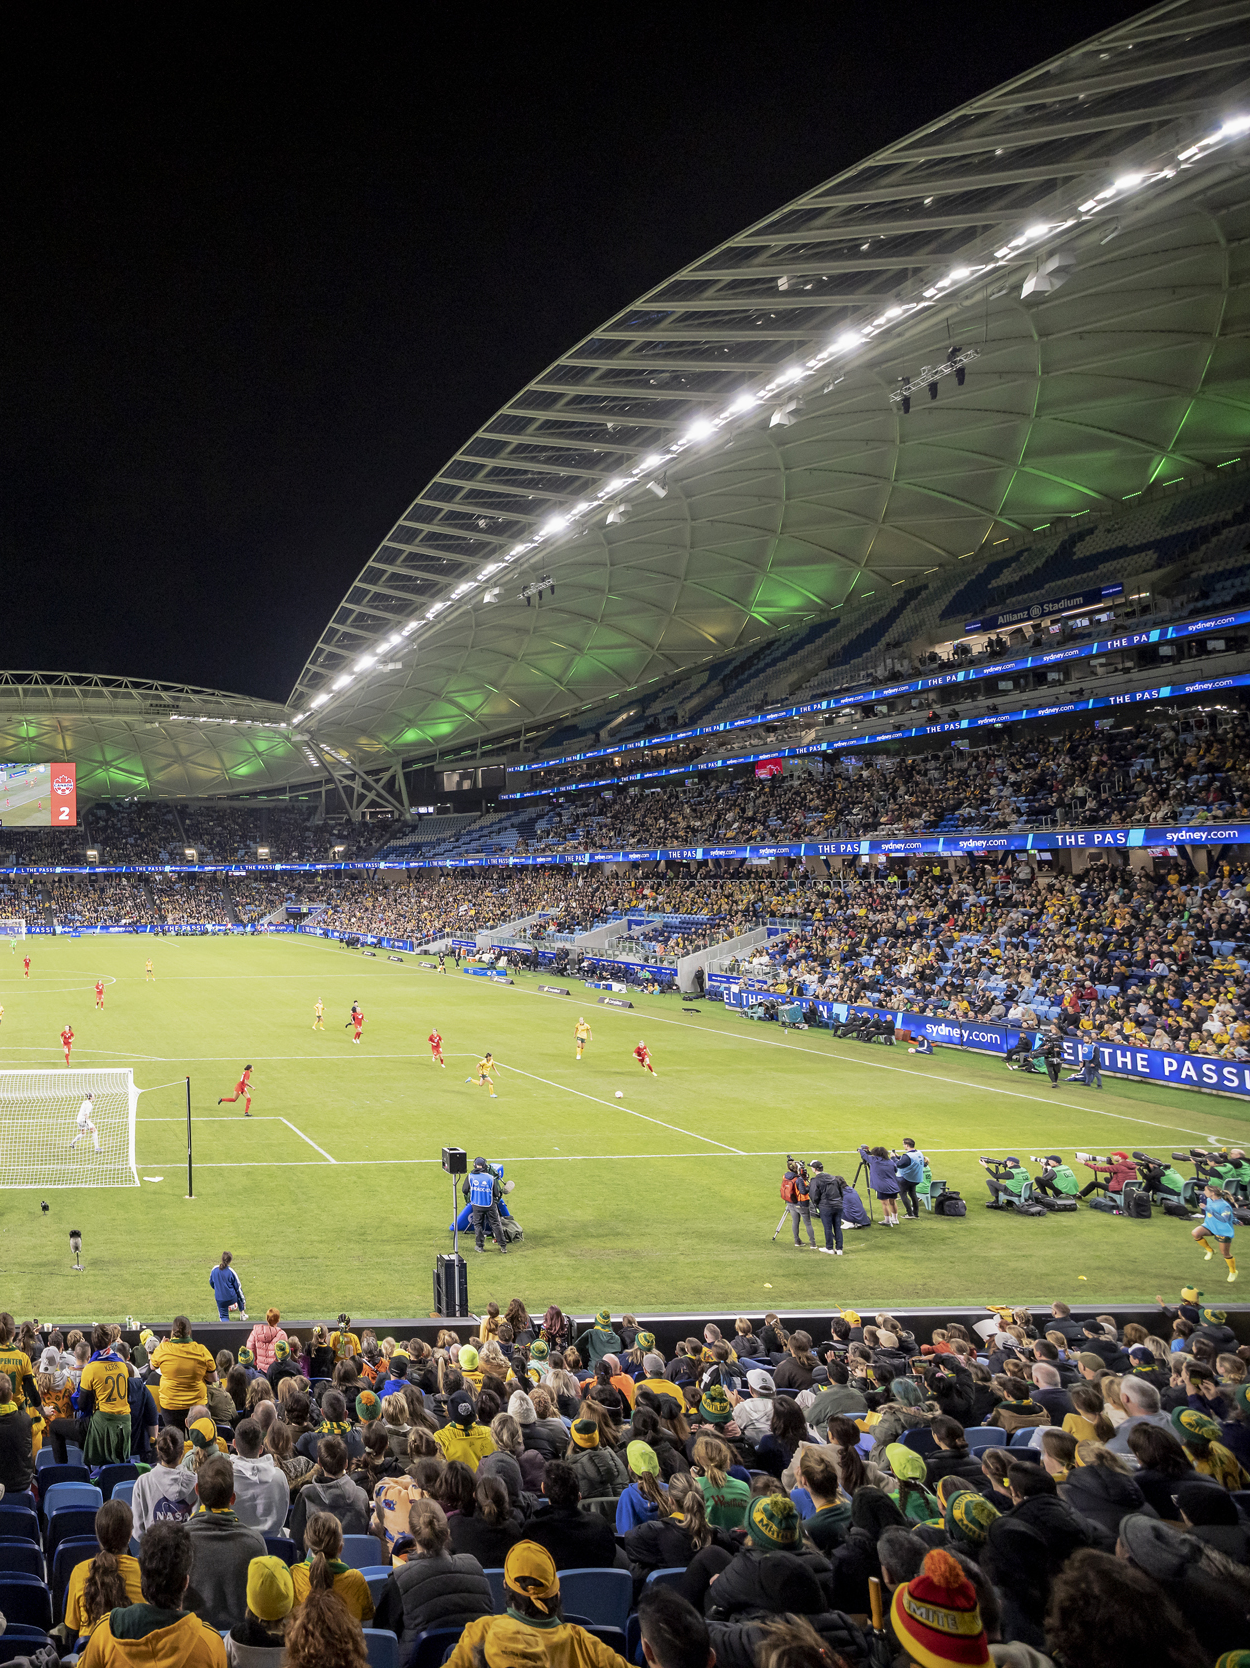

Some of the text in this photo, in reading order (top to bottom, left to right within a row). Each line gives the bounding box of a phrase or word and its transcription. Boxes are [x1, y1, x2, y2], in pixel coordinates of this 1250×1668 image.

[998, 597, 1083, 625] Allianz Stadium
[1188, 617, 1234, 631] sydney.com
[1108, 638, 1127, 648] THE
[1043, 650, 1079, 661] sydney.com
[984, 663, 1015, 674] sydney.com
[929, 678, 942, 686] THE
[1185, 680, 1232, 692] sydney.com
[1109, 691, 1158, 704] THE PAS
[1038, 705, 1074, 715] sydney.com
[978, 716, 1009, 727] sydney.com
[59, 807, 70, 820] 2
[1056, 833, 1125, 845] THE PAS
[1166, 831, 1238, 841] sydney.com
[818, 844, 859, 853] THE PAS
[882, 842, 921, 851] sydney.com
[959, 839, 1007, 848] sydney.com
[759, 848, 789, 856] sydney.com
[724, 992, 736, 1004] EL
[926, 1022, 1000, 1044] sydney.com
[1100, 1048, 1148, 1072] THE
[104, 1363, 120, 1373] KERR
[105, 1373, 126, 1402] 20
[156, 1511, 190, 1523] NASA
